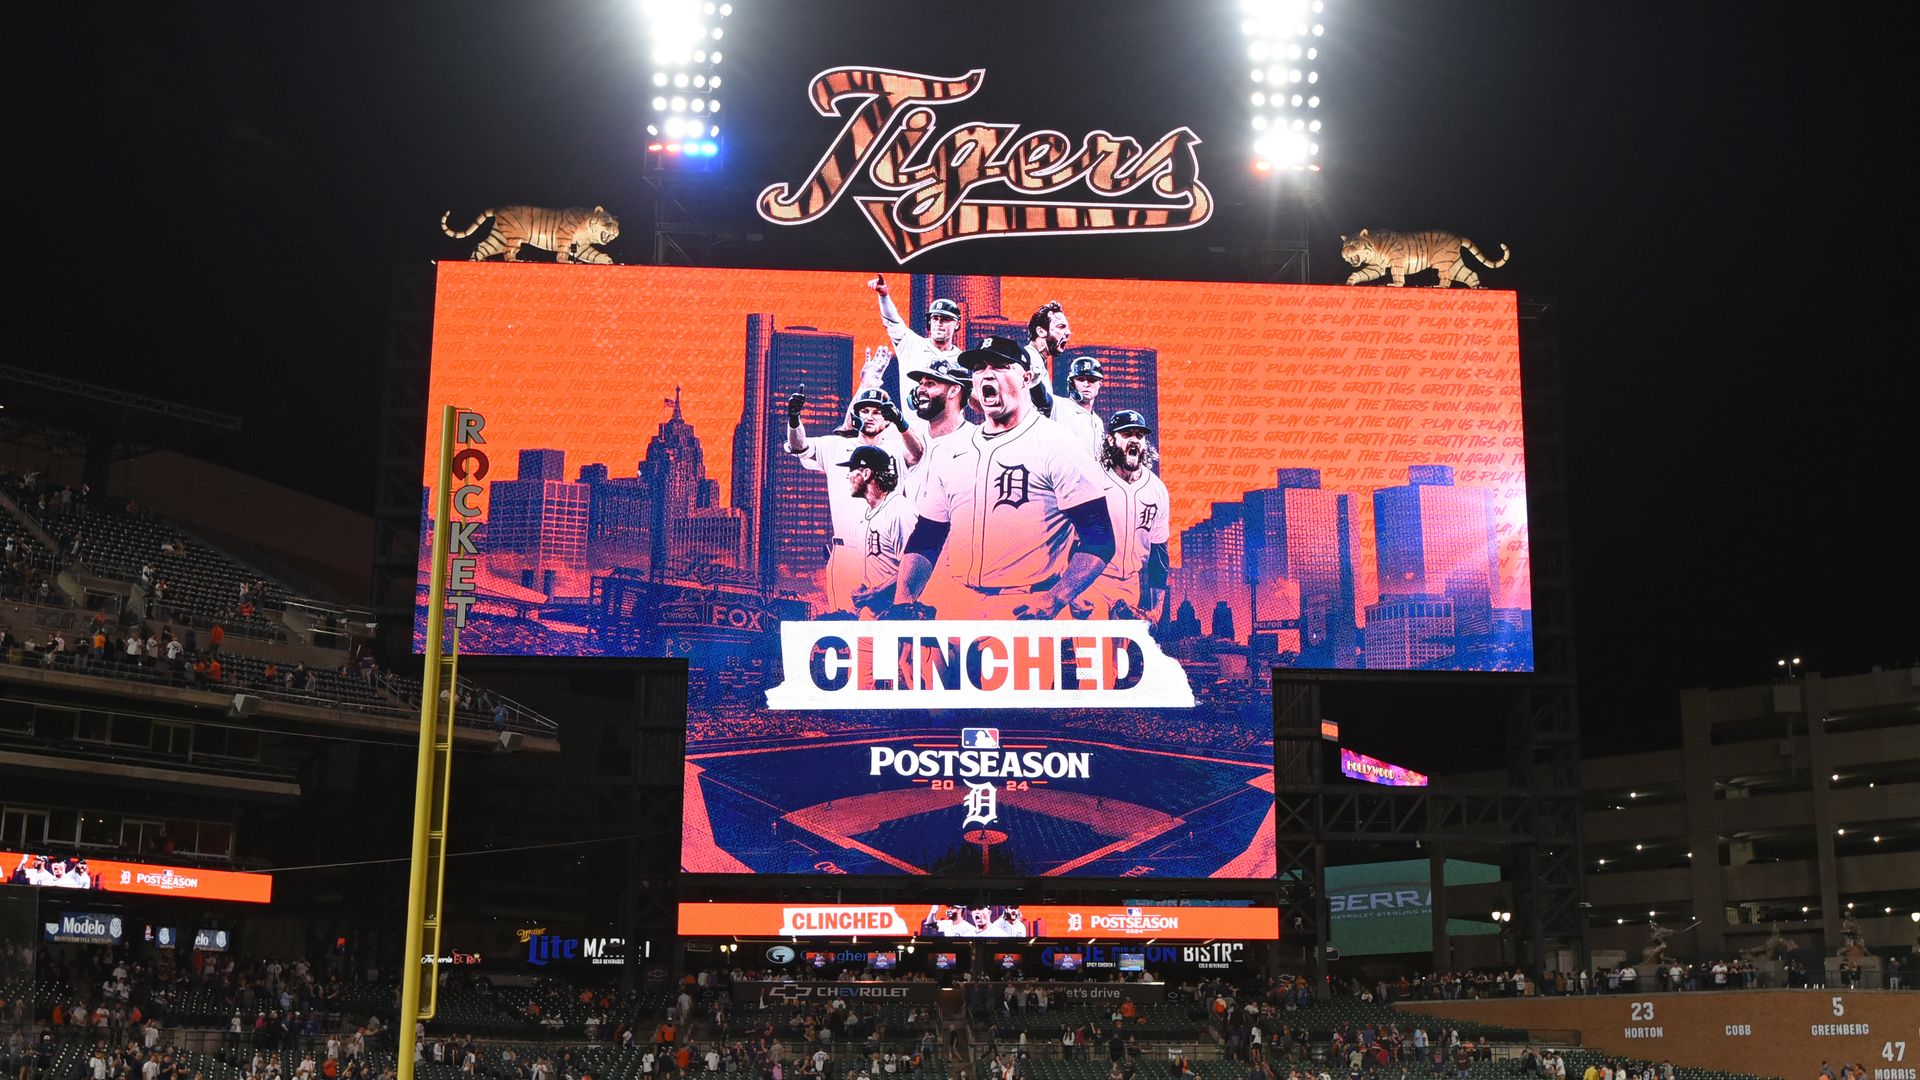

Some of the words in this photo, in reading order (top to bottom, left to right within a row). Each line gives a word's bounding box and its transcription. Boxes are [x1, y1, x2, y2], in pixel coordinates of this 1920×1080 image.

[756, 66, 1214, 263] Tigers
[1200, 344, 1226, 356] THE
[1227, 344, 1273, 357] TIGERS
[1276, 346, 1306, 358] WON
[1307, 346, 1347, 359] AGAIN
[1353, 348, 1379, 360] THE
[1380, 348, 1426, 361] TIGERS
[1428, 350, 1458, 362] WON
[1459, 350, 1499, 363] AGAIN
[1167, 360, 1203, 373] PLAY
[1204, 361, 1230, 373] THE
[1232, 362, 1258, 374] CITY
[1265, 362, 1300, 375] PLAY
[1302, 363, 1317, 376] US
[1321, 364, 1356, 376] PLAY
[1358, 365, 1383, 377] THE
[1385, 365, 1412, 378] CITY
[1418, 366, 1453, 379] PLAY
[1454, 367, 1470, 379] US
[1473, 368, 1509, 380] PLAY
[1184, 378, 1231, 391] GRITTY
[1229, 379, 1259, 391] TIGS
[1263, 379, 1310, 392] GRITTY
[1308, 380, 1338, 393] TIGS
[1342, 381, 1389, 394] GRITTY
[1387, 382, 1416, 395] TIGS
[1420, 383, 1467, 396] GRITTY
[1465, 384, 1494, 397] TIGS
[1200, 395, 1227, 408] THE
[1228, 396, 1274, 409] TIGERS
[1277, 397, 1307, 410] WON
[1308, 398, 1349, 410] AGAIN
[1354, 399, 1381, 411] THE
[1382, 399, 1428, 412] TIGERS
[1430, 400, 1460, 413] WON
[1461, 401, 1501, 414] AGAIN
[1167, 412, 1204, 424] PLAY
[1205, 412, 1231, 425] THE
[1232, 413, 1260, 426] CITY
[1266, 414, 1302, 427] PLAY
[1303, 415, 1319, 427] US
[1322, 415, 1358, 428] PLAY
[1359, 416, 1385, 428] THE
[1386, 417, 1413, 429] CITY
[1420, 417, 1455, 430] PLAY
[1456, 418, 1472, 430] US
[1475, 419, 1511, 431] PLAY
[1184, 429, 1232, 442] GRITTY
[1230, 430, 1260, 443] TIGS
[1264, 431, 1311, 444] GRITTY
[1309, 432, 1339, 445] TIGS
[1343, 433, 1390, 446] GRITTY
[1388, 434, 1418, 446] TIGS
[1422, 434, 1469, 448] GRITTY
[1467, 436, 1497, 448] TIGS
[713, 605, 764, 632] FOX
[809, 635, 1144, 692] CLINCHED
[869, 746, 1090, 778] POSTSEASON
[1346, 760, 1395, 780] HOLLYWOOD
[962, 779, 998, 829] D
[137, 874, 198, 888] POSTSEASON
[63, 917, 105, 935] Modelo
[792, 912, 892, 930] CLINCHED
[1091, 917, 1178, 929] POSTSEASON
[527, 934, 578, 966] Lite
[817, 987, 910, 997] CHEVROLET
[1090, 987, 1120, 998] drive
[1630, 1001, 1654, 1022] 23
[1832, 997, 1845, 1017] 5
[1624, 1026, 1664, 1039] HORTON
[1725, 1024, 1752, 1036] COBB
[1811, 1023, 1870, 1037] GREENBERG
[1882, 1041, 1906, 1062] 47
[1875, 1068, 1917, 1080] MORRIS
